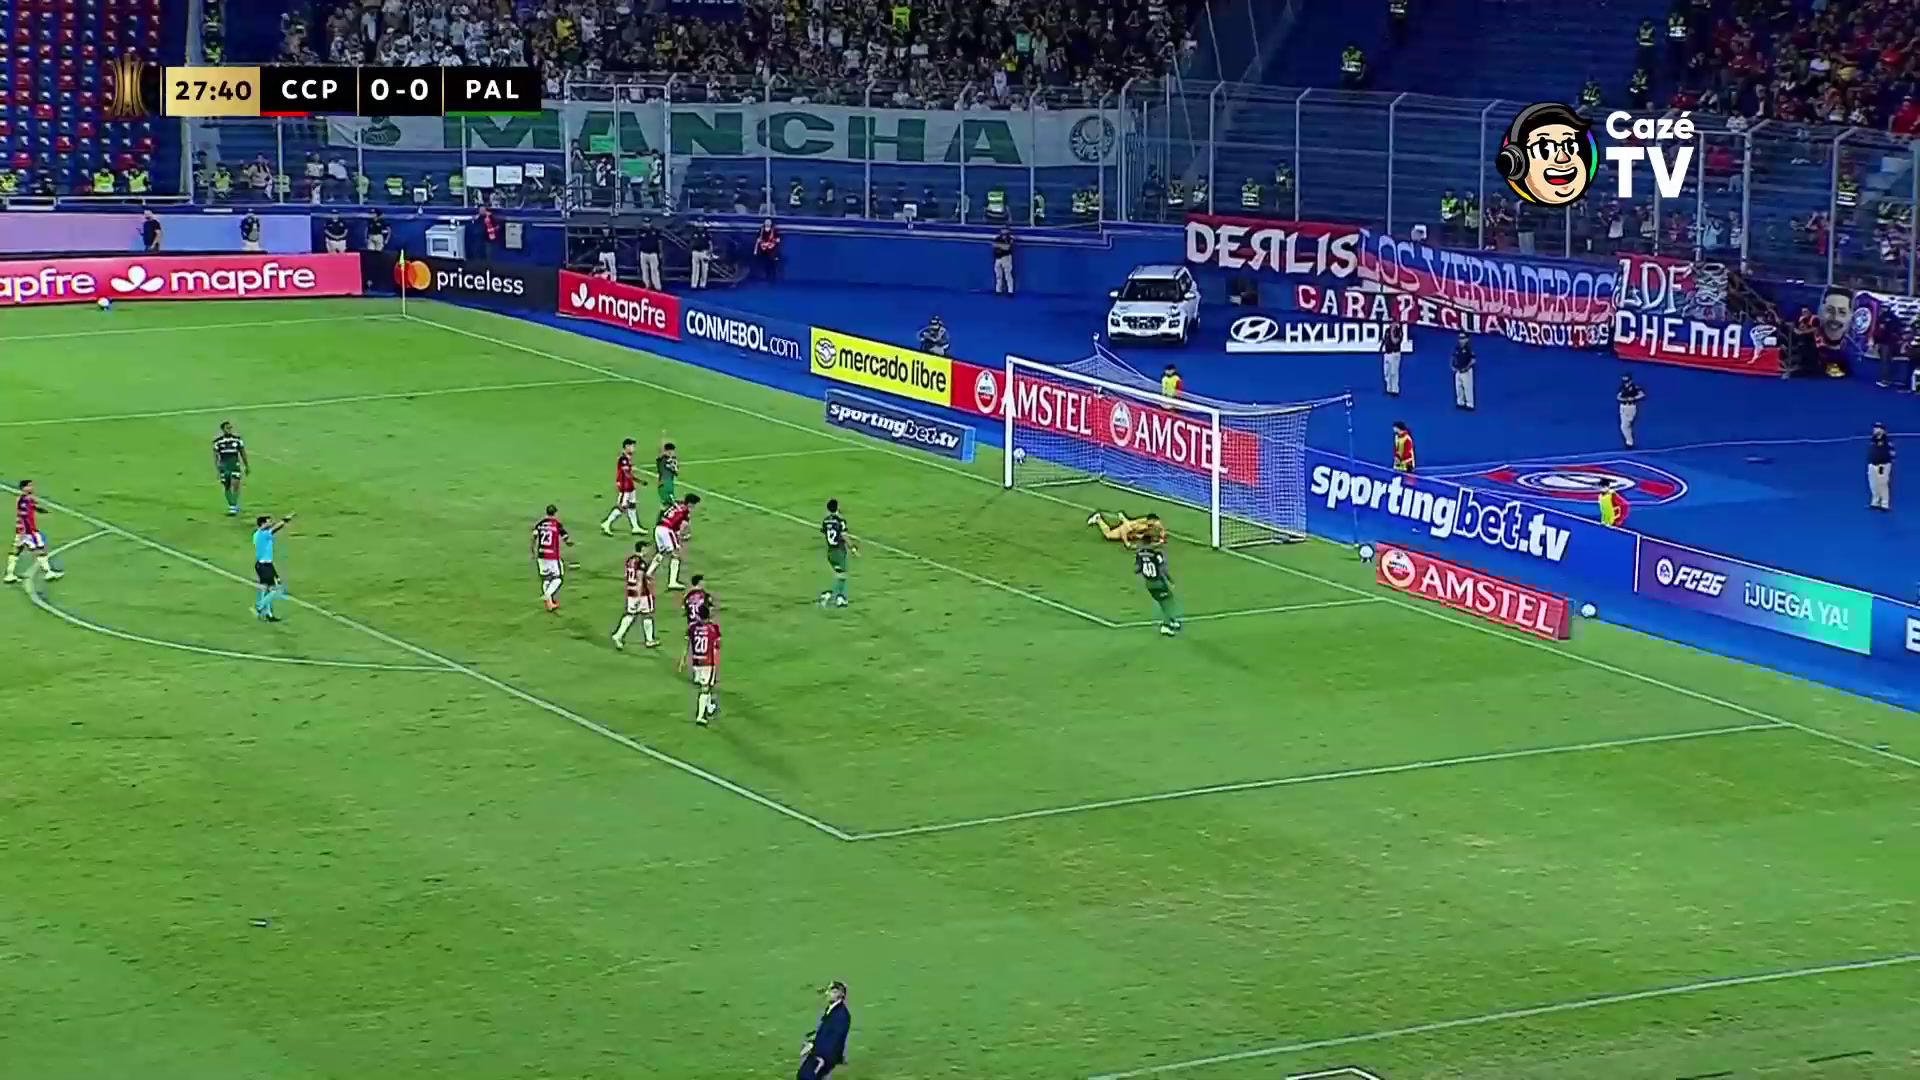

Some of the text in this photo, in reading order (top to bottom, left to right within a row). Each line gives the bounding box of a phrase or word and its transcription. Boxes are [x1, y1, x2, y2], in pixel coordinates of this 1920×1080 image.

[443, 106, 1022, 165] MANCHA
[170, 262, 316, 295] mapfre
[437, 269, 524, 296] priceless
[1357, 228, 1614, 324] LOS VERDADEROS
[598, 293, 666, 328] mapfre
[1504, 317, 1611, 347] MARQUITOS
[1614, 310, 1742, 359] CHEMA
[838, 346, 947, 393] mercado libre
[830, 403, 959, 449] sportingbet.tv
[1311, 465, 1571, 562] sportingbet.tv
[540, 530, 553, 546] 23
[1419, 563, 1554, 633] AMSTEL
[1817, 600, 1849, 631] YA!
[694, 636, 709, 653] 20
